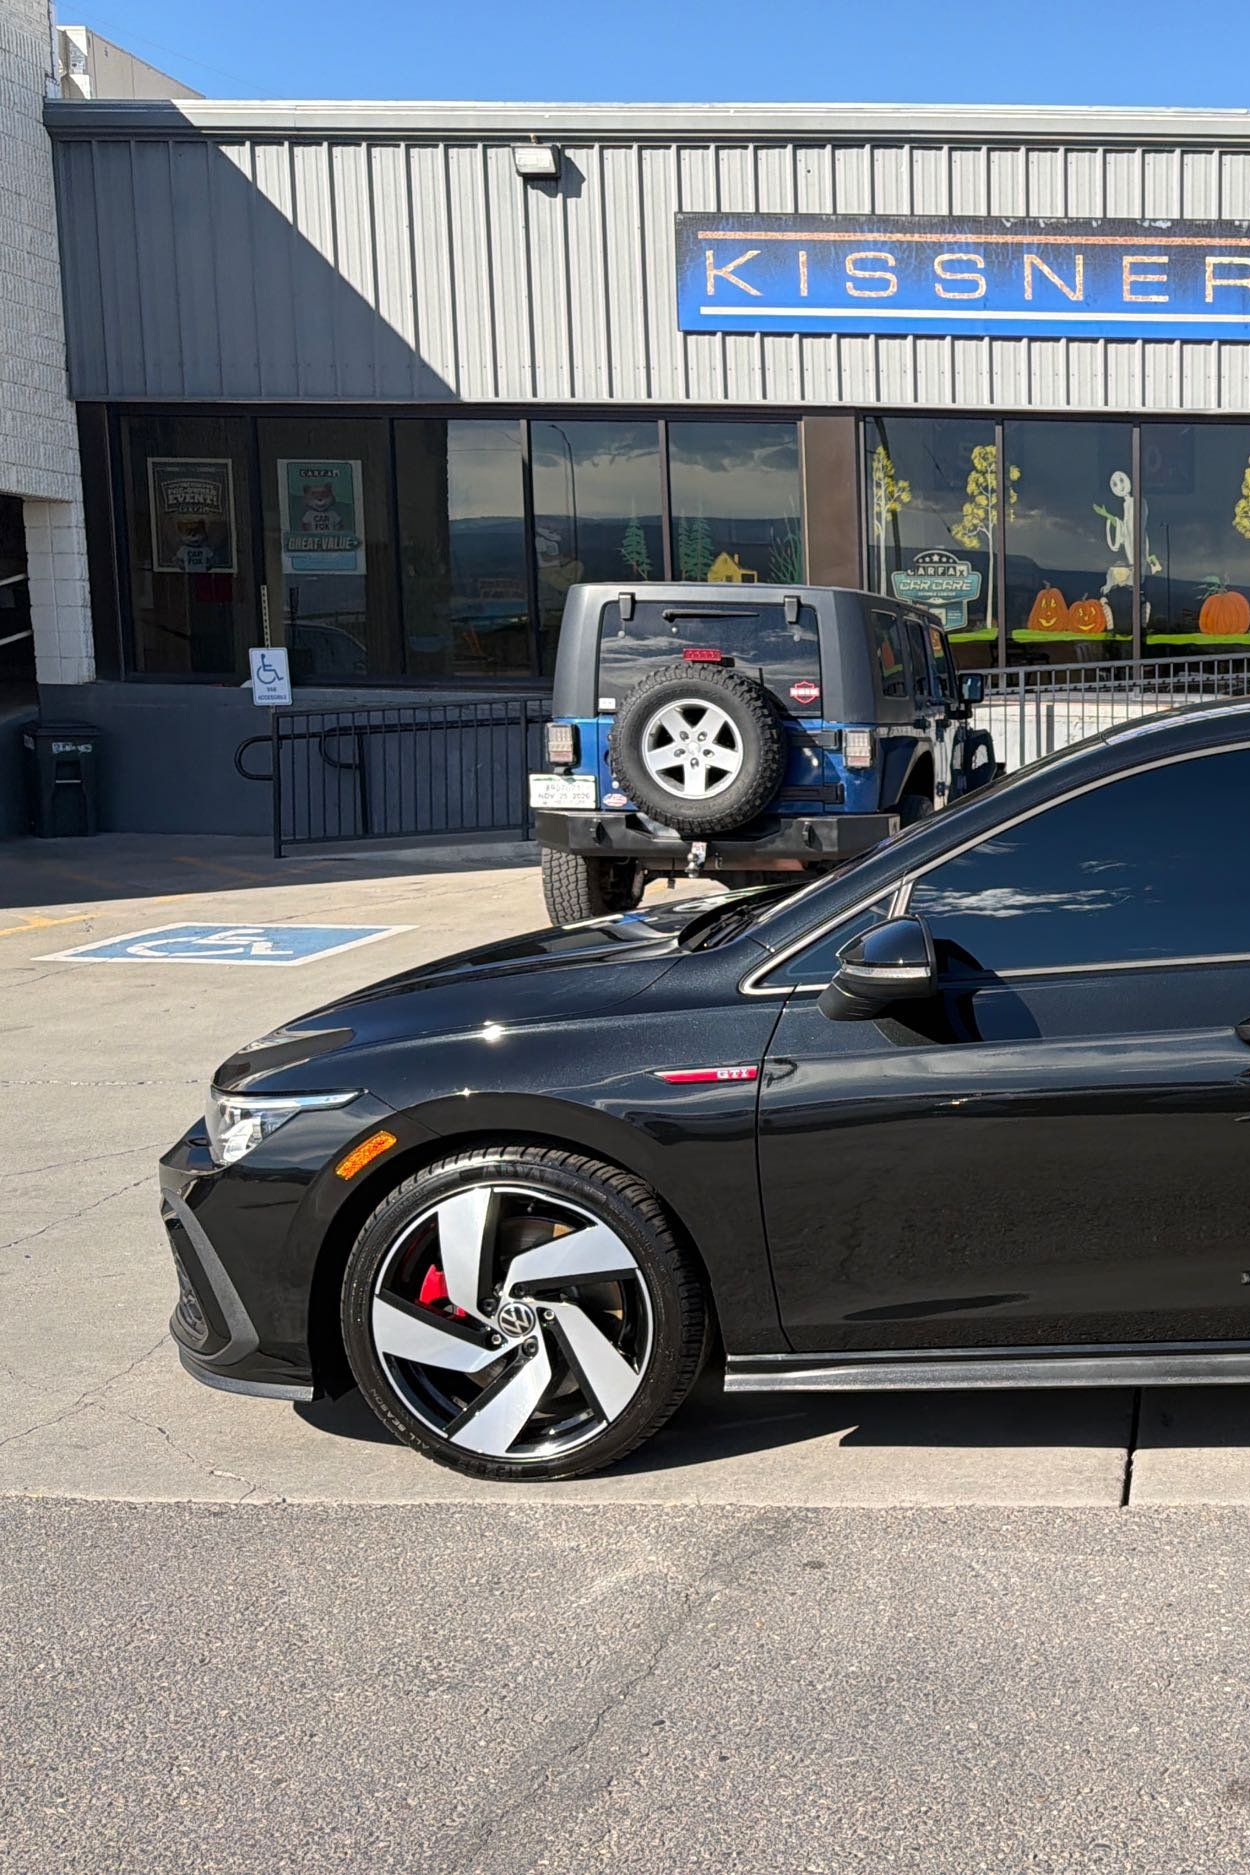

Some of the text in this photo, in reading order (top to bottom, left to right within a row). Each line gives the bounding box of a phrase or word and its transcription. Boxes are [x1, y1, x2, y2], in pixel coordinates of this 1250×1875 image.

[288, 536, 351, 551] GREAT VALUE
[907, 565, 968, 577] CARFAX
[899, 580, 973, 591] CAR CARE
[716, 1068, 749, 1080] GTI
